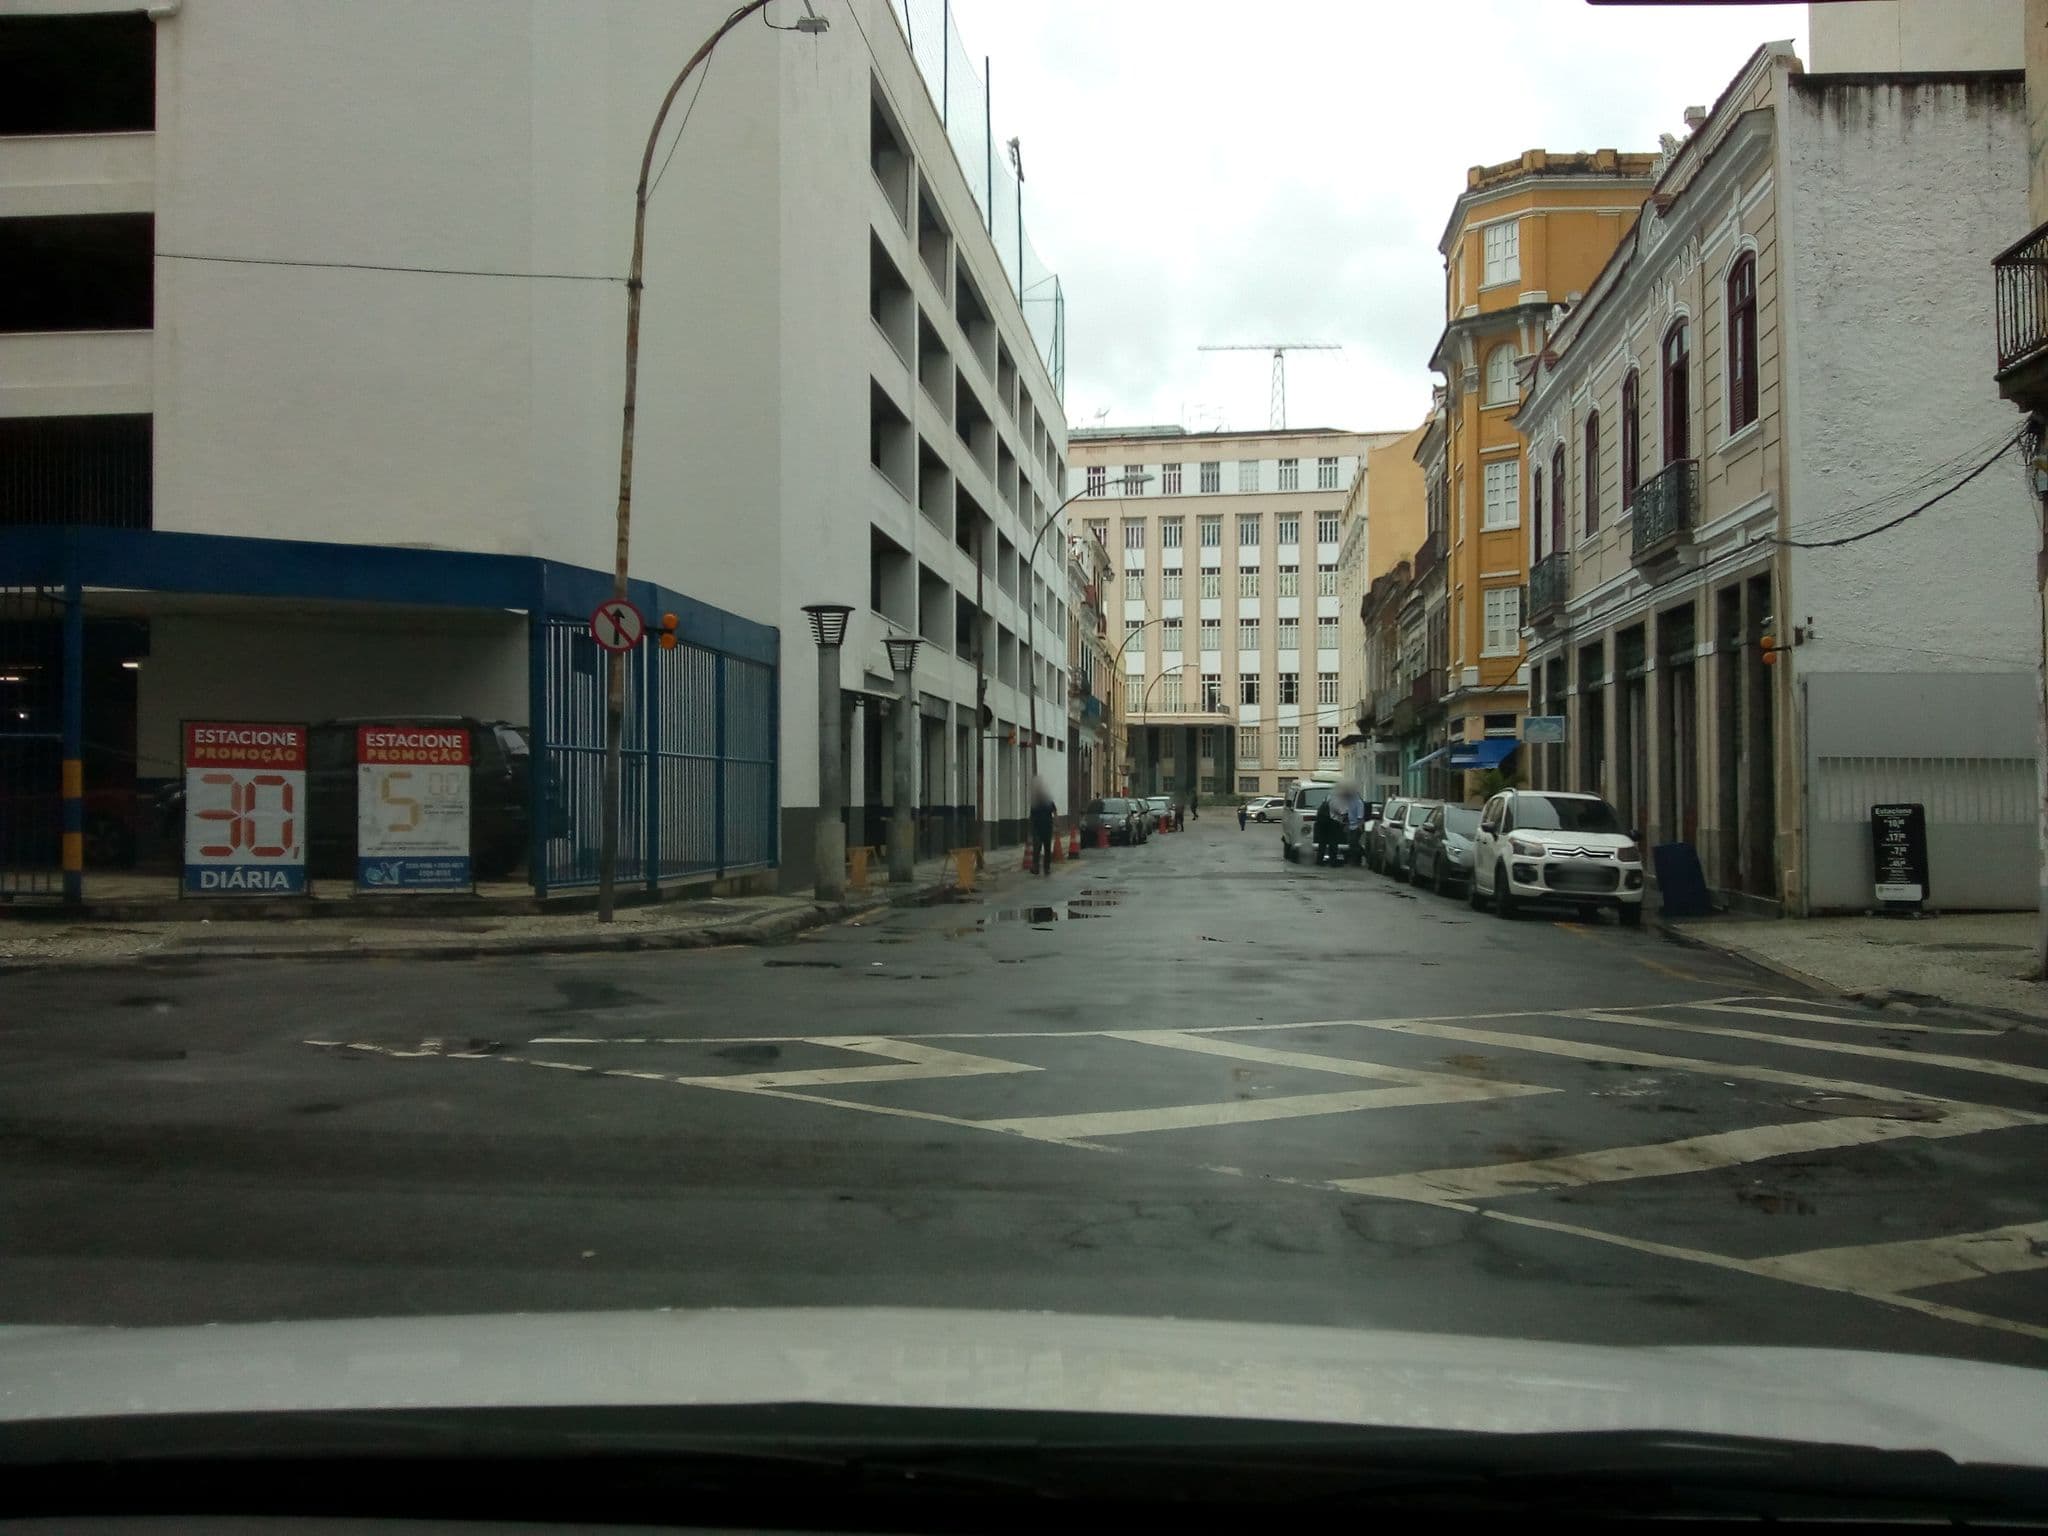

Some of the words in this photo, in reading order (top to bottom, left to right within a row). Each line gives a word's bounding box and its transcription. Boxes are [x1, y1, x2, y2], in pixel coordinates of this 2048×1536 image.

[194, 729, 297, 746] ESTACIONE
[365, 733, 462, 748] ESTACIONE
[194, 747, 297, 762] PROMOÇÃO
[366, 748, 463, 762] PROMOÇÃO
[200, 866, 290, 889] DIÁRIA
